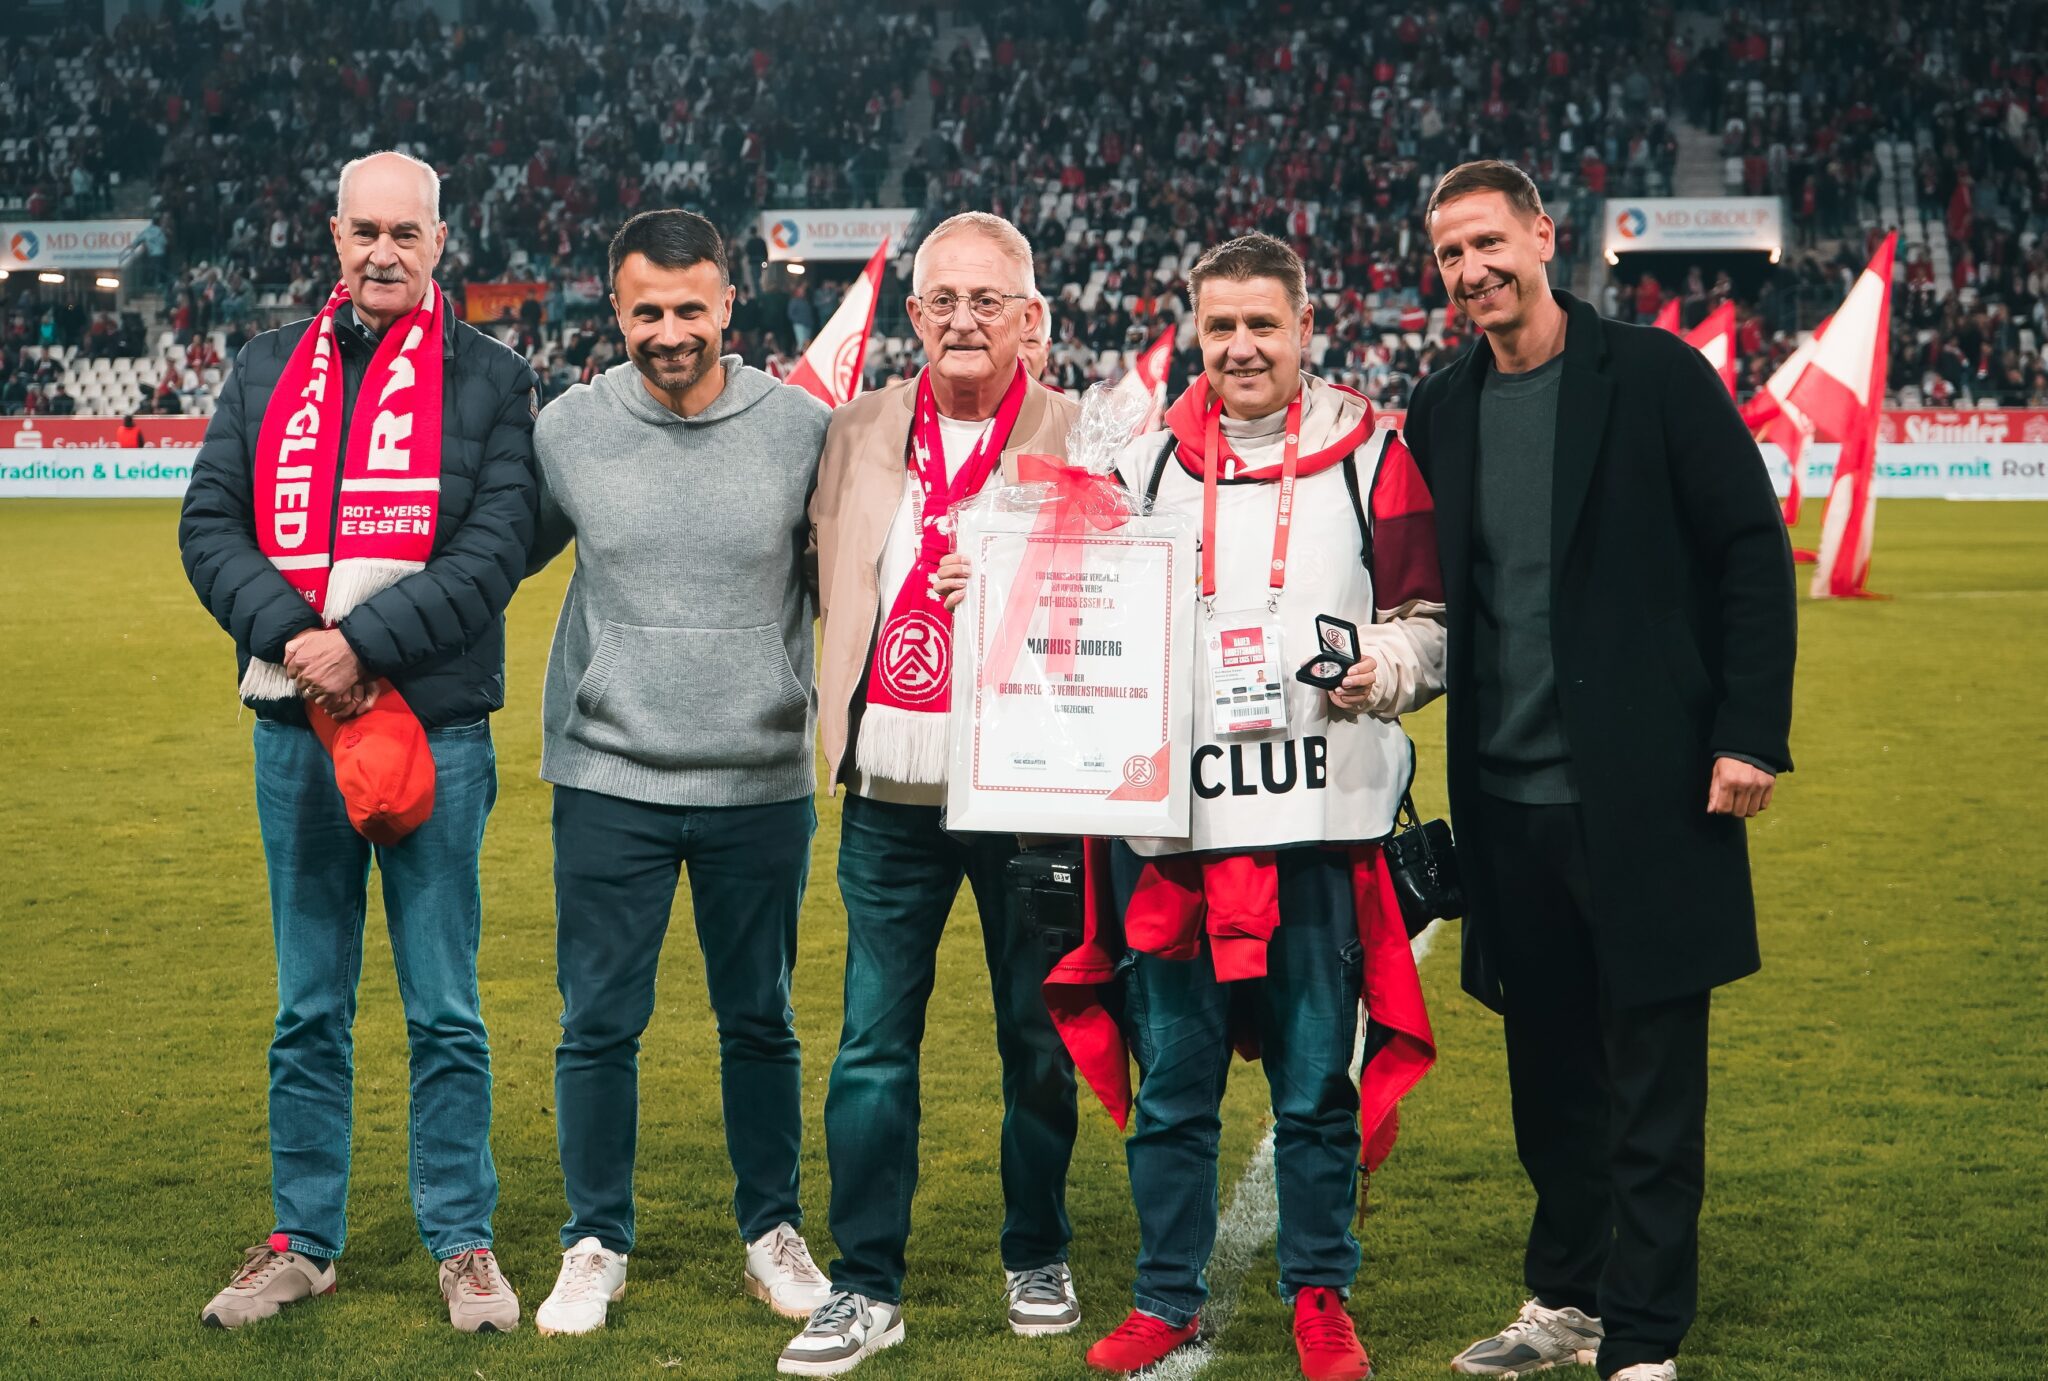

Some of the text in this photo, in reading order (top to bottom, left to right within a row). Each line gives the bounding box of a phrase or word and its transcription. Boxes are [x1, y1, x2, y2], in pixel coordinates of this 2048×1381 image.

[1655, 207, 1769, 227] MD GROUP
[806, 221, 839, 239] MD
[47, 231, 78, 250] MD
[53, 436, 206, 448] Sparkae Esse
[0, 461, 192, 479] radition & Leiden
[1949, 458, 1990, 477] mit
[342, 505, 431, 518] ROT-WEISS
[341, 520, 430, 535] ESSEN
[1039, 596, 1078, 608] ROT-WEISS
[1079, 598, 1101, 609] ESSEN
[1027, 638, 1122, 656] MARKUS ENDBERG
[1064, 674, 1085, 682] MIT DER
[999, 683, 1149, 699] GEORG MELCS VERDIENSTMEDAILLE 2025
[1055, 705, 1095, 714] GEZEICHNET.
[1191, 736, 1328, 799] CLUB
